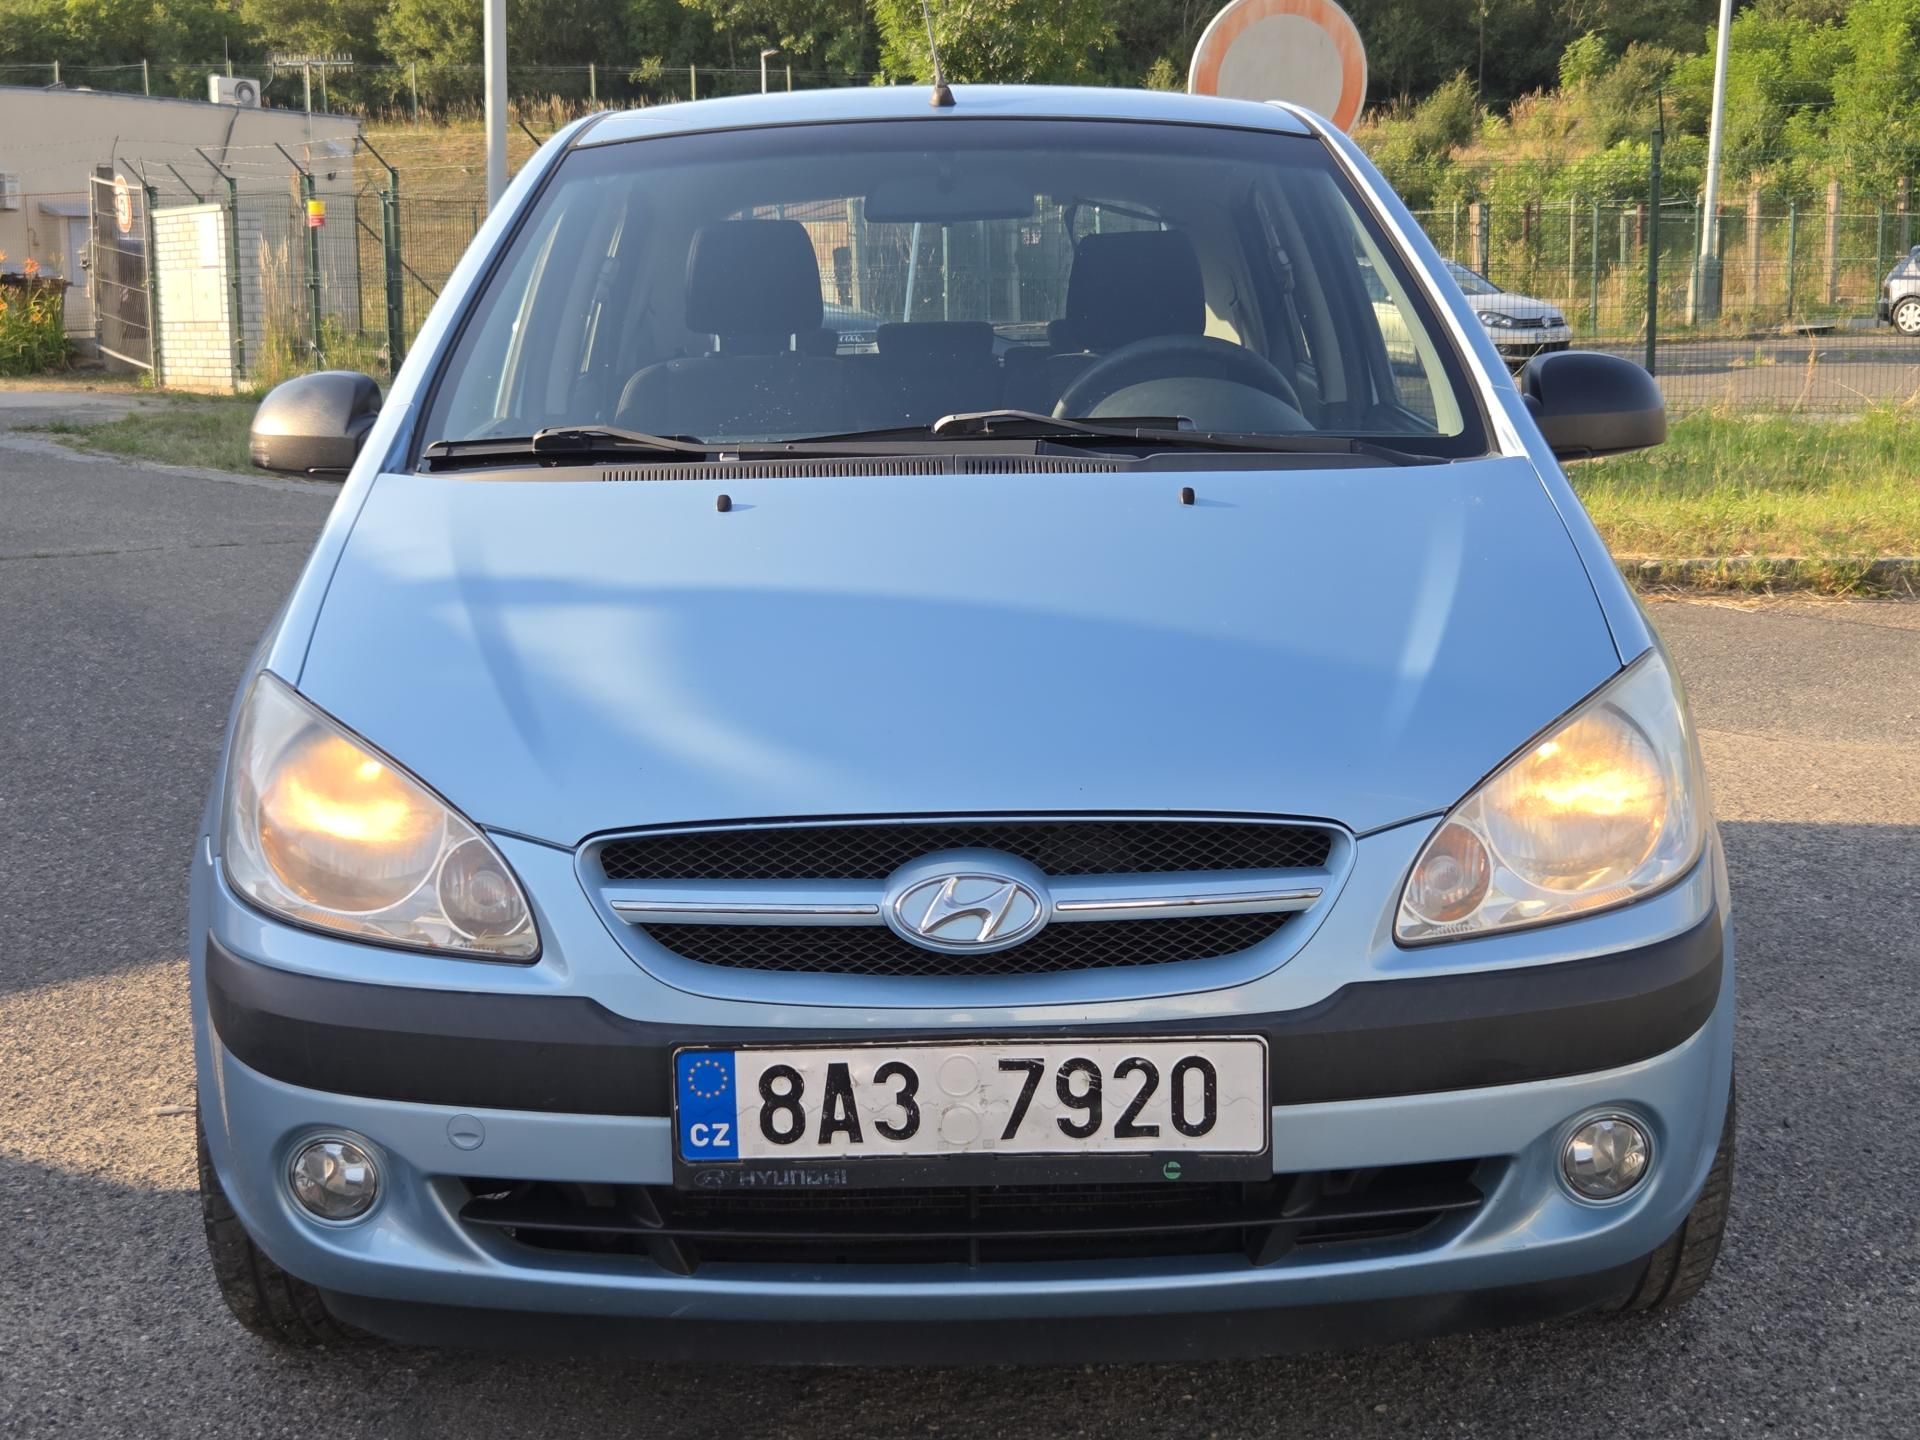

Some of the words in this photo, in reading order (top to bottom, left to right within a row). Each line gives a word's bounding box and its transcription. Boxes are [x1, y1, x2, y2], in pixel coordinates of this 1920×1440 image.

[758, 1061, 920, 1145] 8A3
[998, 1055, 1217, 1140] 7920
[690, 1123, 730, 1147] CZ
